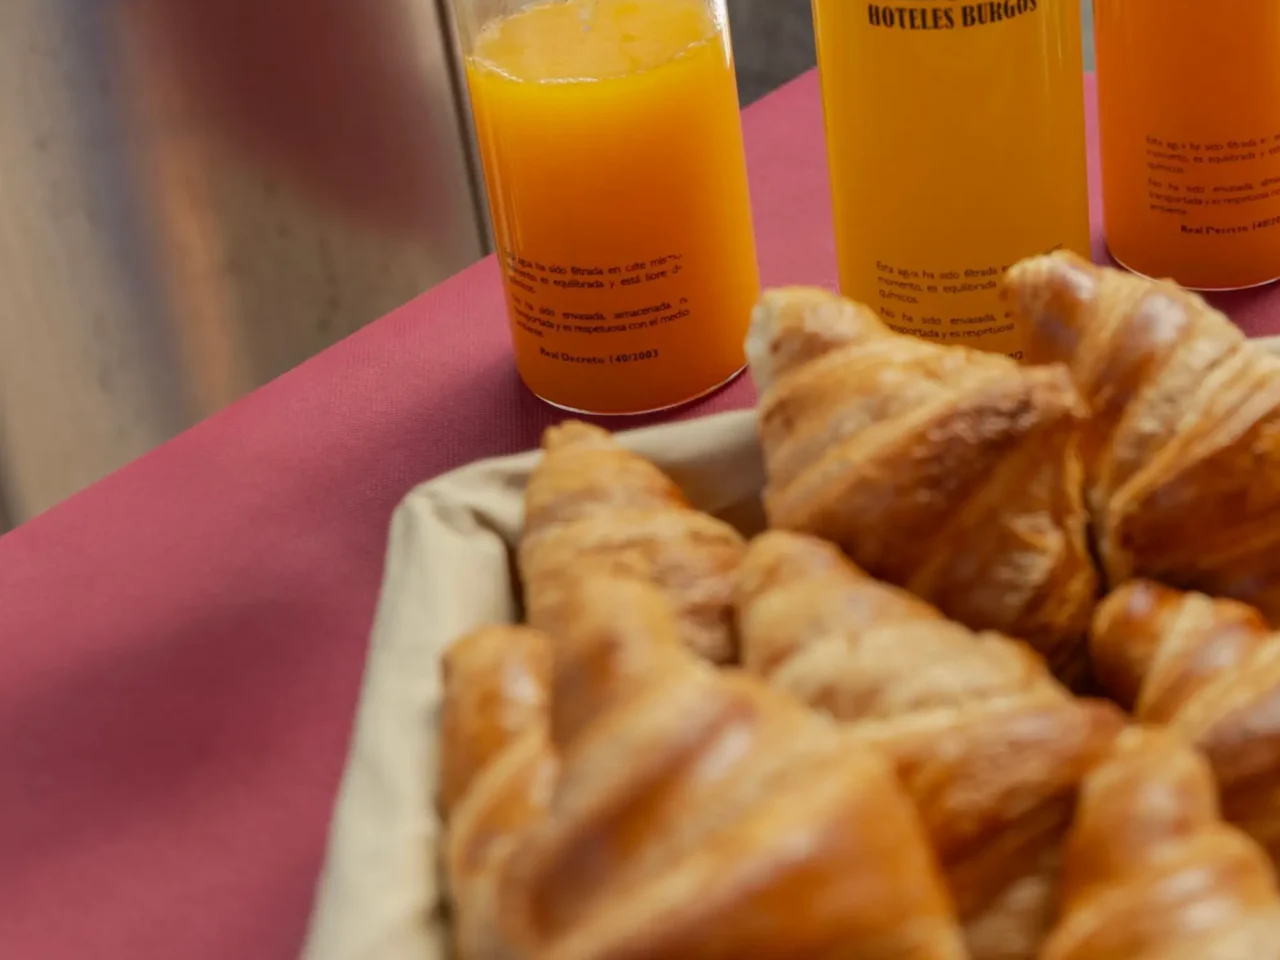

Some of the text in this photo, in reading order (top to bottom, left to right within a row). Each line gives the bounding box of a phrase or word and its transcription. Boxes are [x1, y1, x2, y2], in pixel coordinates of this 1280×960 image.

[867, 3, 954, 30] HOTELES
[1180, 224, 1203, 235] Real
[888, 321, 940, 339] ansportada
[539, 345, 559, 360] Real
[562, 351, 605, 365] Decreto
